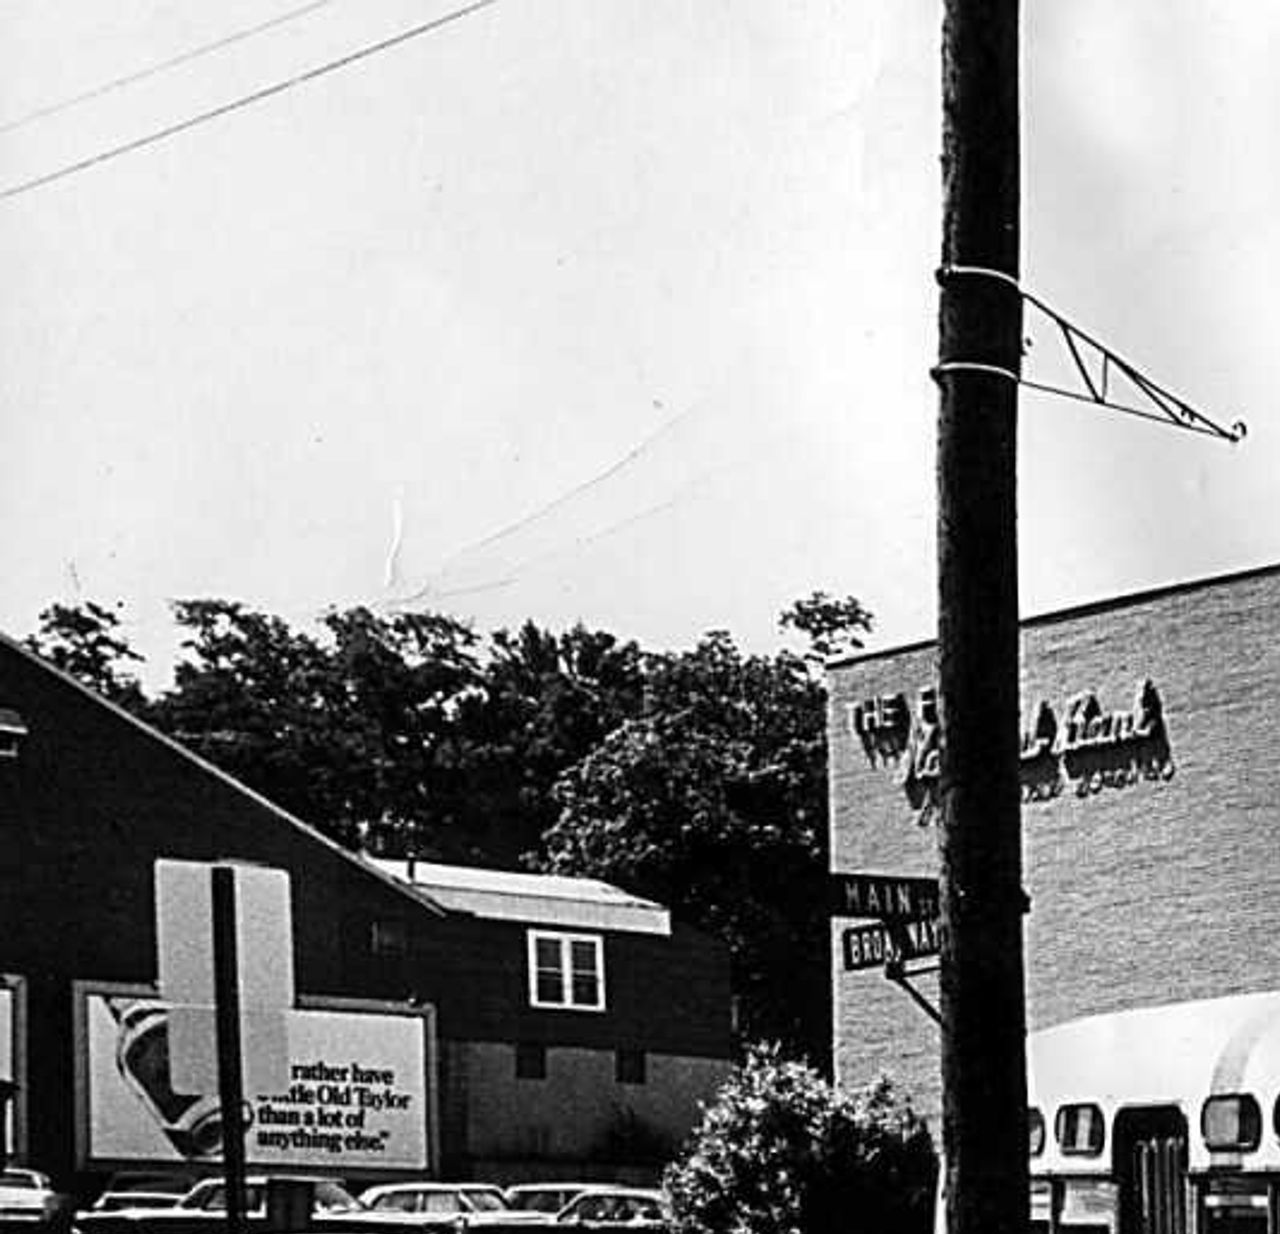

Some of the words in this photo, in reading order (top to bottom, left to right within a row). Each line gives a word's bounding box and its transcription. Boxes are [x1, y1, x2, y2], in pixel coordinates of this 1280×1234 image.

[844, 880, 911, 915] MAIN
[290, 1061, 349, 1081] rather
[351, 1062, 395, 1085] have
[317, 1085, 350, 1106] Old
[352, 1087, 413, 1111] Taylor
[257, 1104, 300, 1125] than
[303, 1110, 315, 1126] a
[317, 1107, 343, 1128] lot
[345, 1109, 366, 1129] of
[257, 1128, 342, 1153] anything
